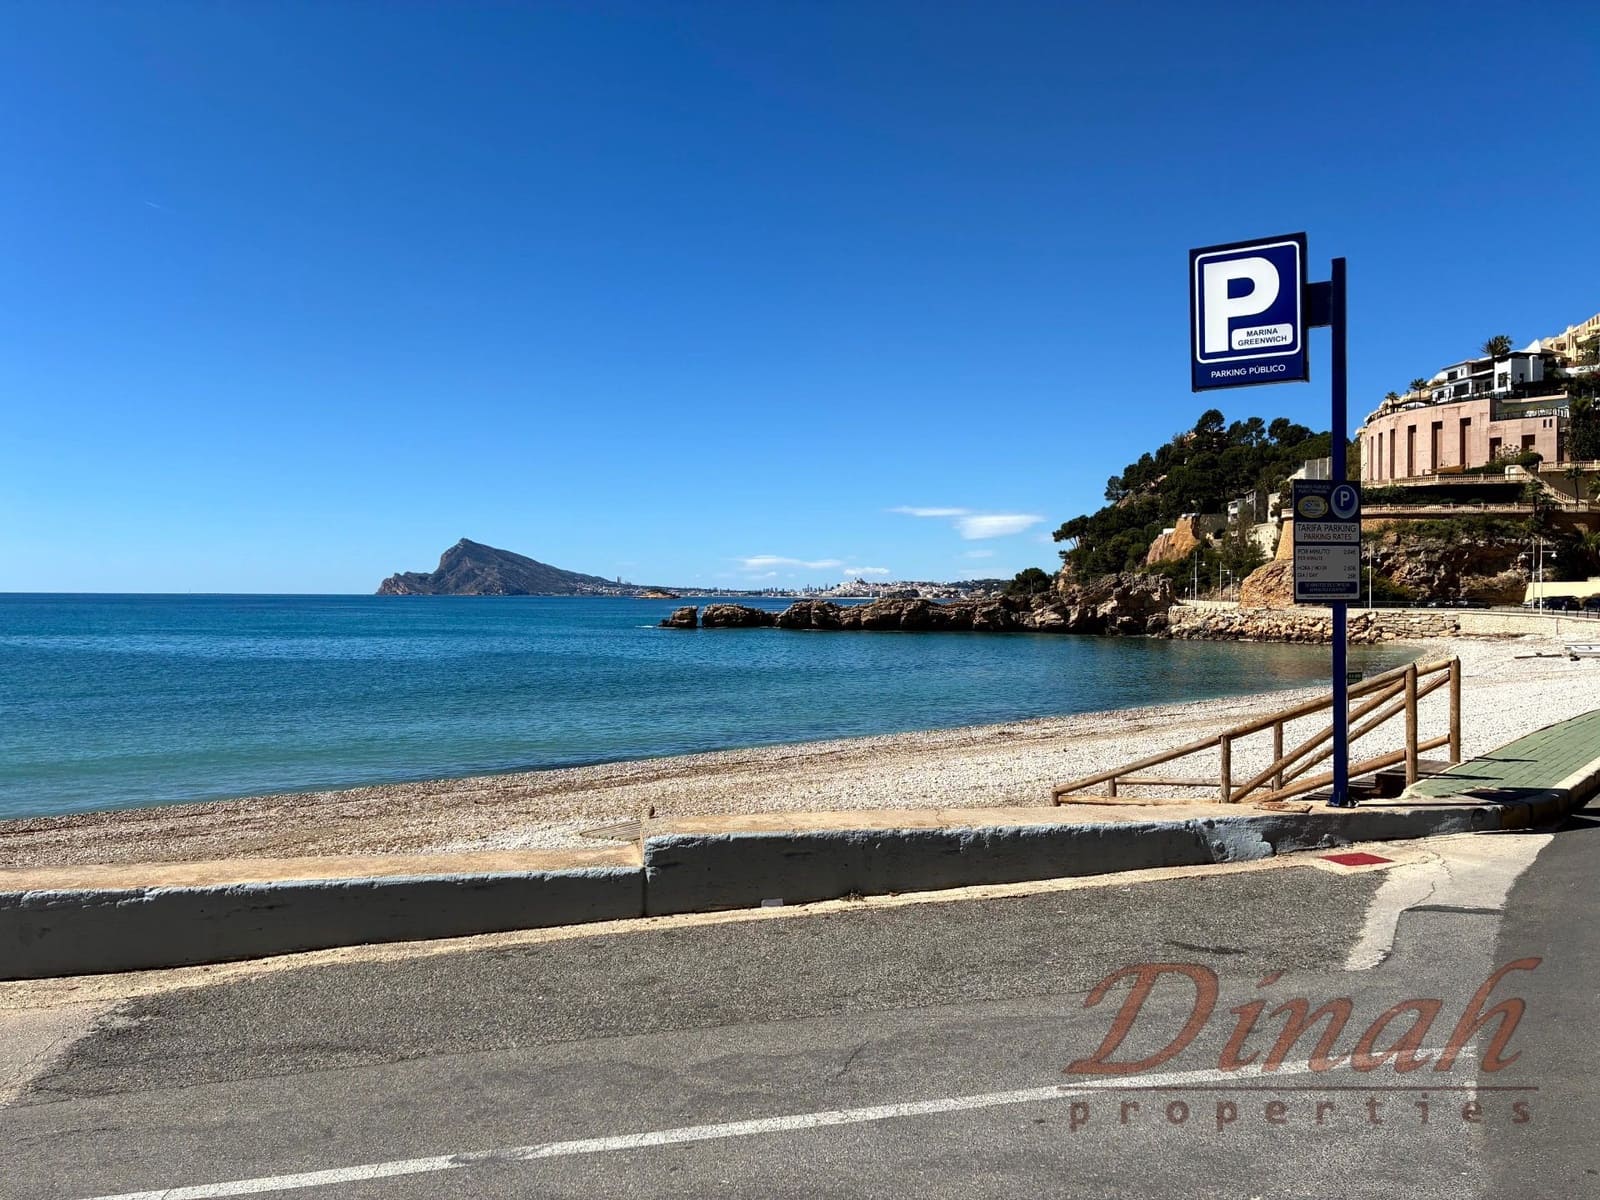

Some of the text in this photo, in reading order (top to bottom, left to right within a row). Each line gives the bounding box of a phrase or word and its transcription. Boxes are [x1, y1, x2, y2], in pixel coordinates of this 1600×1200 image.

[1203, 256, 1280, 354] P
[1246, 327, 1279, 338] MARINA
[1237, 335, 1288, 347] GREENWICH
[1210, 363, 1286, 379] PARKING PÚBLICO
[1340, 490, 1350, 507] P
[1297, 523, 1357, 533] TARIFA PARKING
[1303, 533, 1331, 541] PARKING
